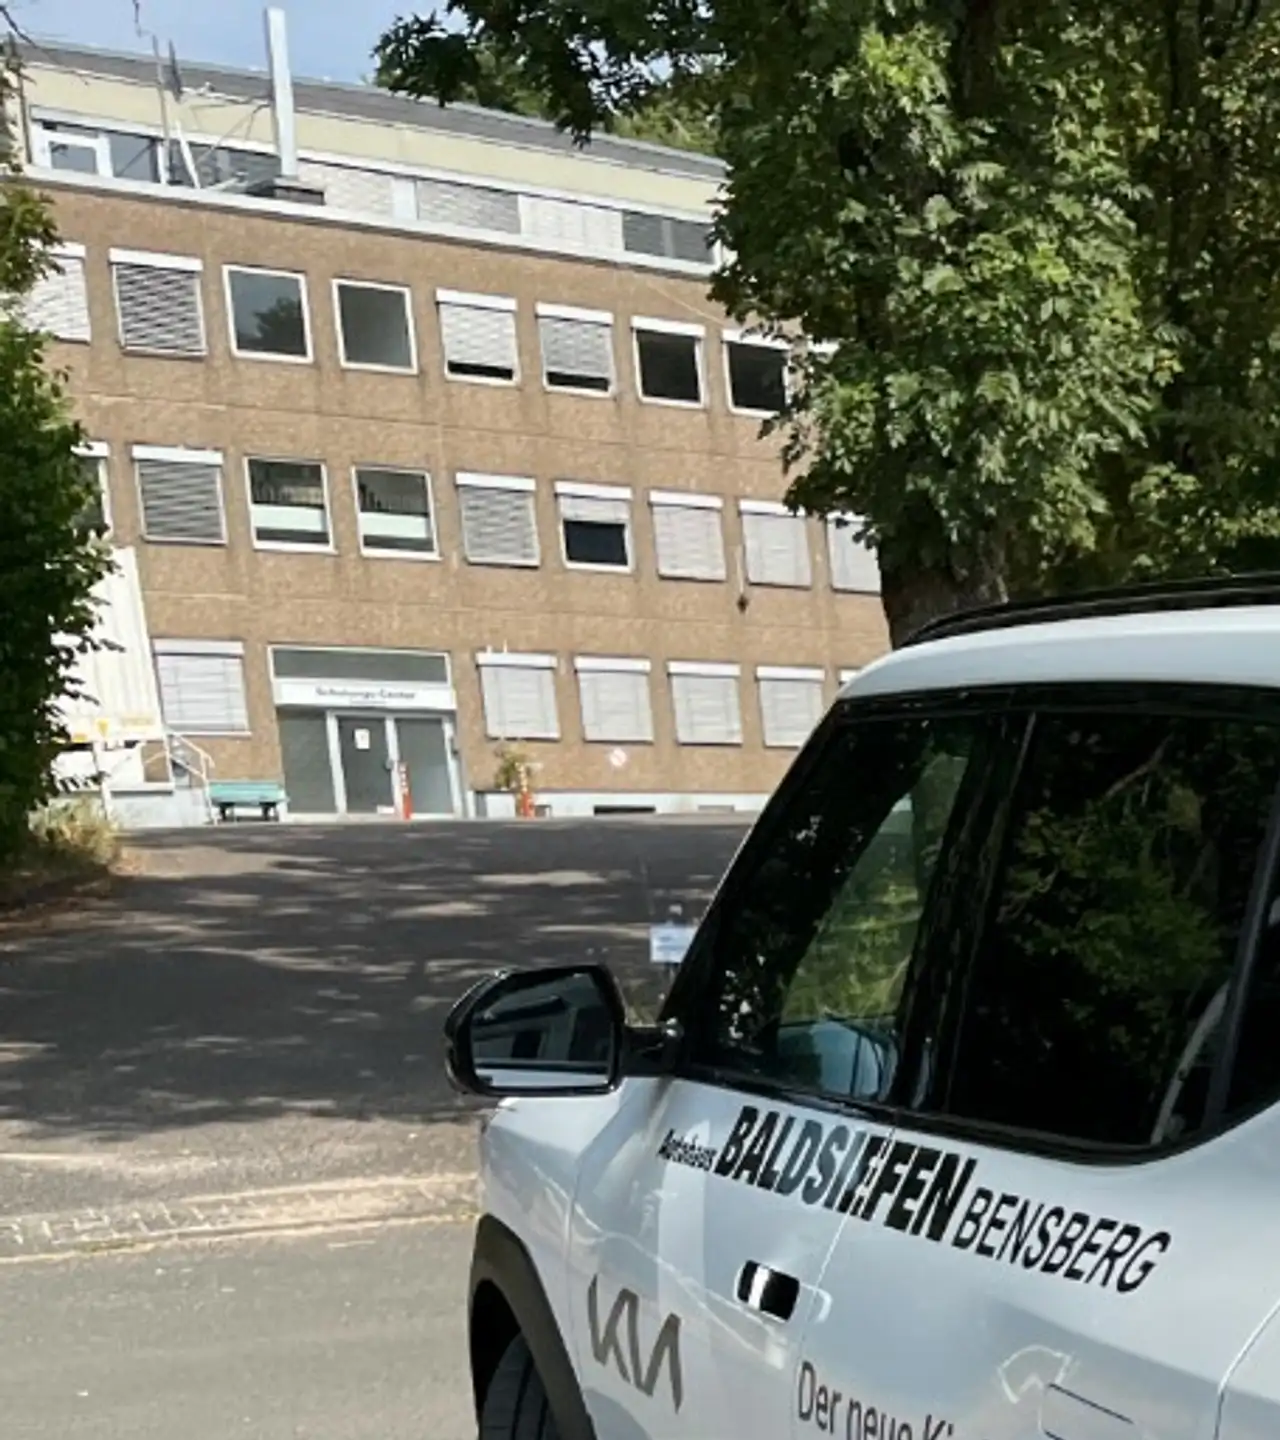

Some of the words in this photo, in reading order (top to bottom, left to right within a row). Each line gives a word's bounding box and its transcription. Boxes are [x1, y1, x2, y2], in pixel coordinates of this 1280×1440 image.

[713, 1105, 978, 1243] BALDSIEFEN
[951, 1187, 1171, 1293] BENSBERG
[588, 1273, 683, 1415] KIA
[798, 1360, 842, 1434] Der
